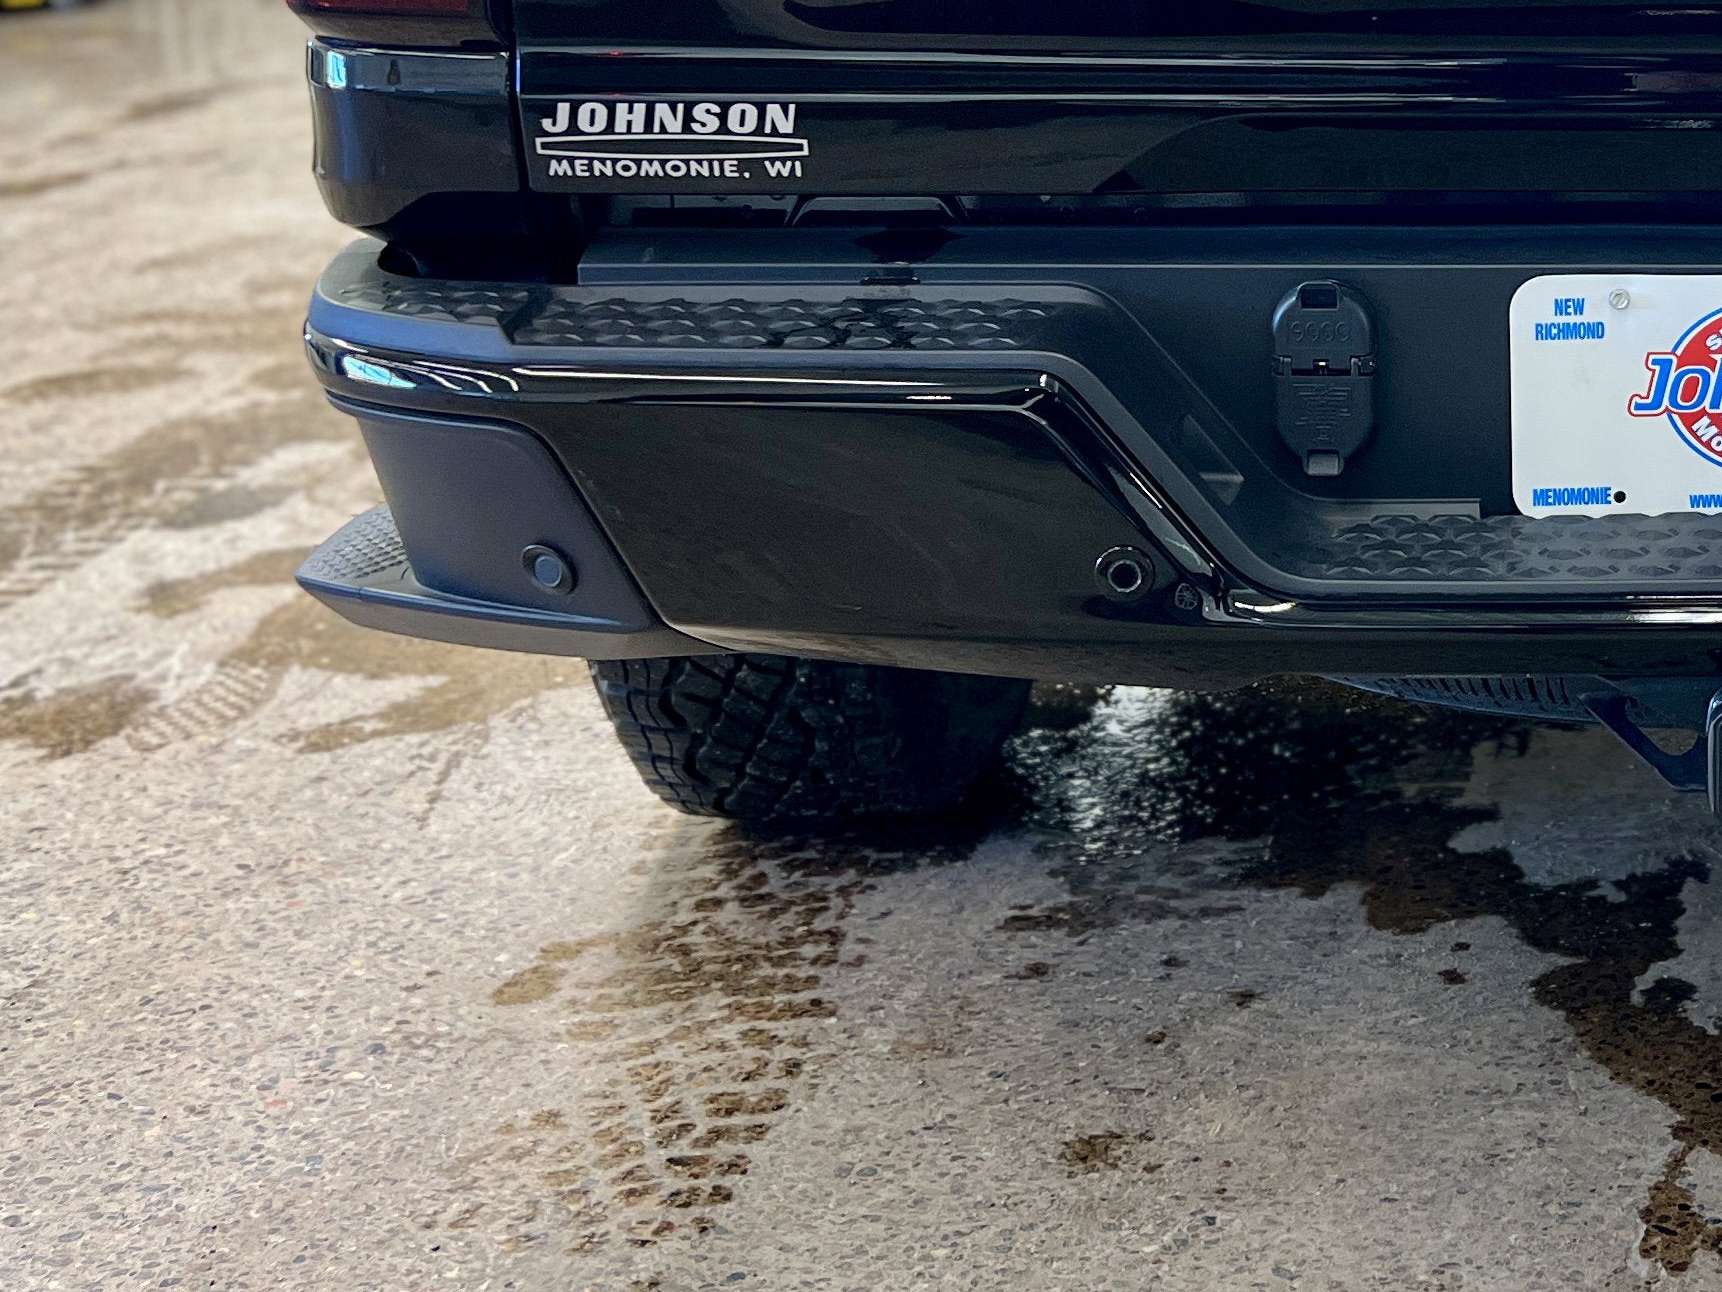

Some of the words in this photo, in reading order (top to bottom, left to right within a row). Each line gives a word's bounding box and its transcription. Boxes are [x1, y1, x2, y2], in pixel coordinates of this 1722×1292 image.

[540, 102, 796, 134] JOHNSON
[764, 160, 802, 178] WI
[1554, 298, 1585, 316] NEW
[1535, 321, 1605, 341] RICHMOND
[1532, 487, 1612, 507] MENOMONIE
